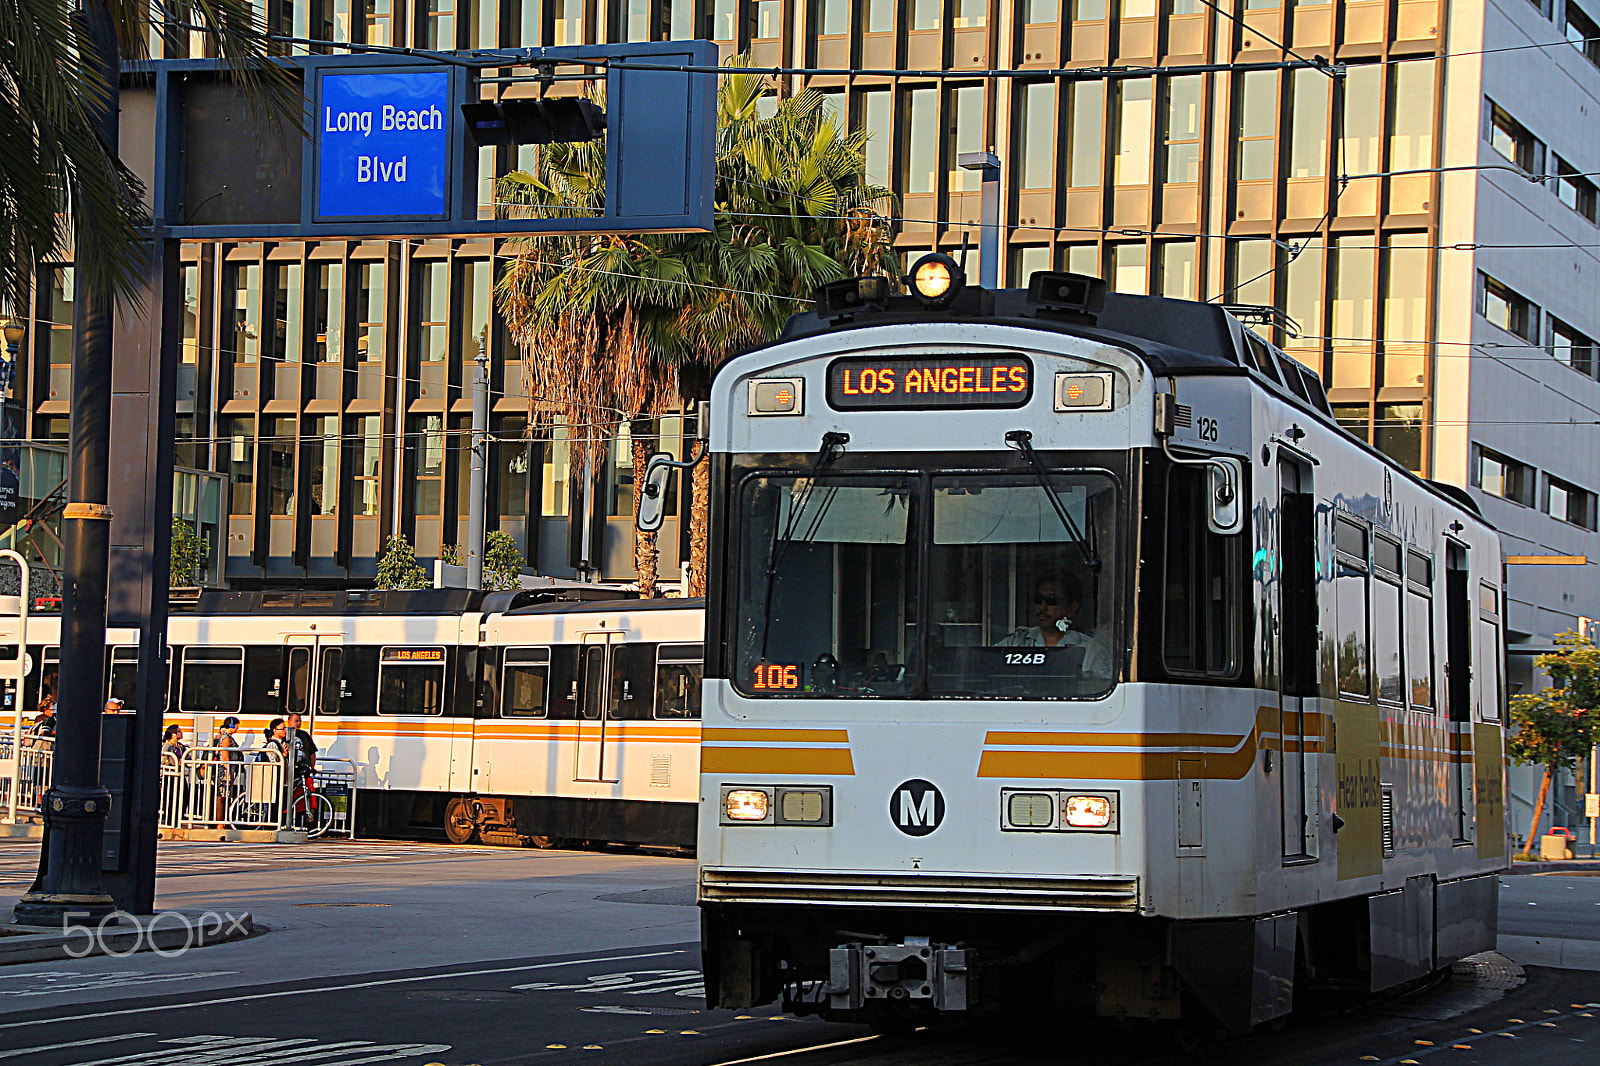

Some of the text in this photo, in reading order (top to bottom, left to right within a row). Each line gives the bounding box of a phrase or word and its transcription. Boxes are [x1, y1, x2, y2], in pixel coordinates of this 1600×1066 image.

[325, 104, 442, 138] Long Beach
[357, 155, 407, 183] Blvd
[843, 366, 1027, 395] LOS ANGELES
[1197, 416, 1218, 442] 126
[397, 651, 441, 660] LOS ANGELES
[1005, 653, 1045, 665] 126B
[753, 664, 799, 689] 106
[1338, 762, 1358, 809] Hear
[900, 789, 936, 827] M
